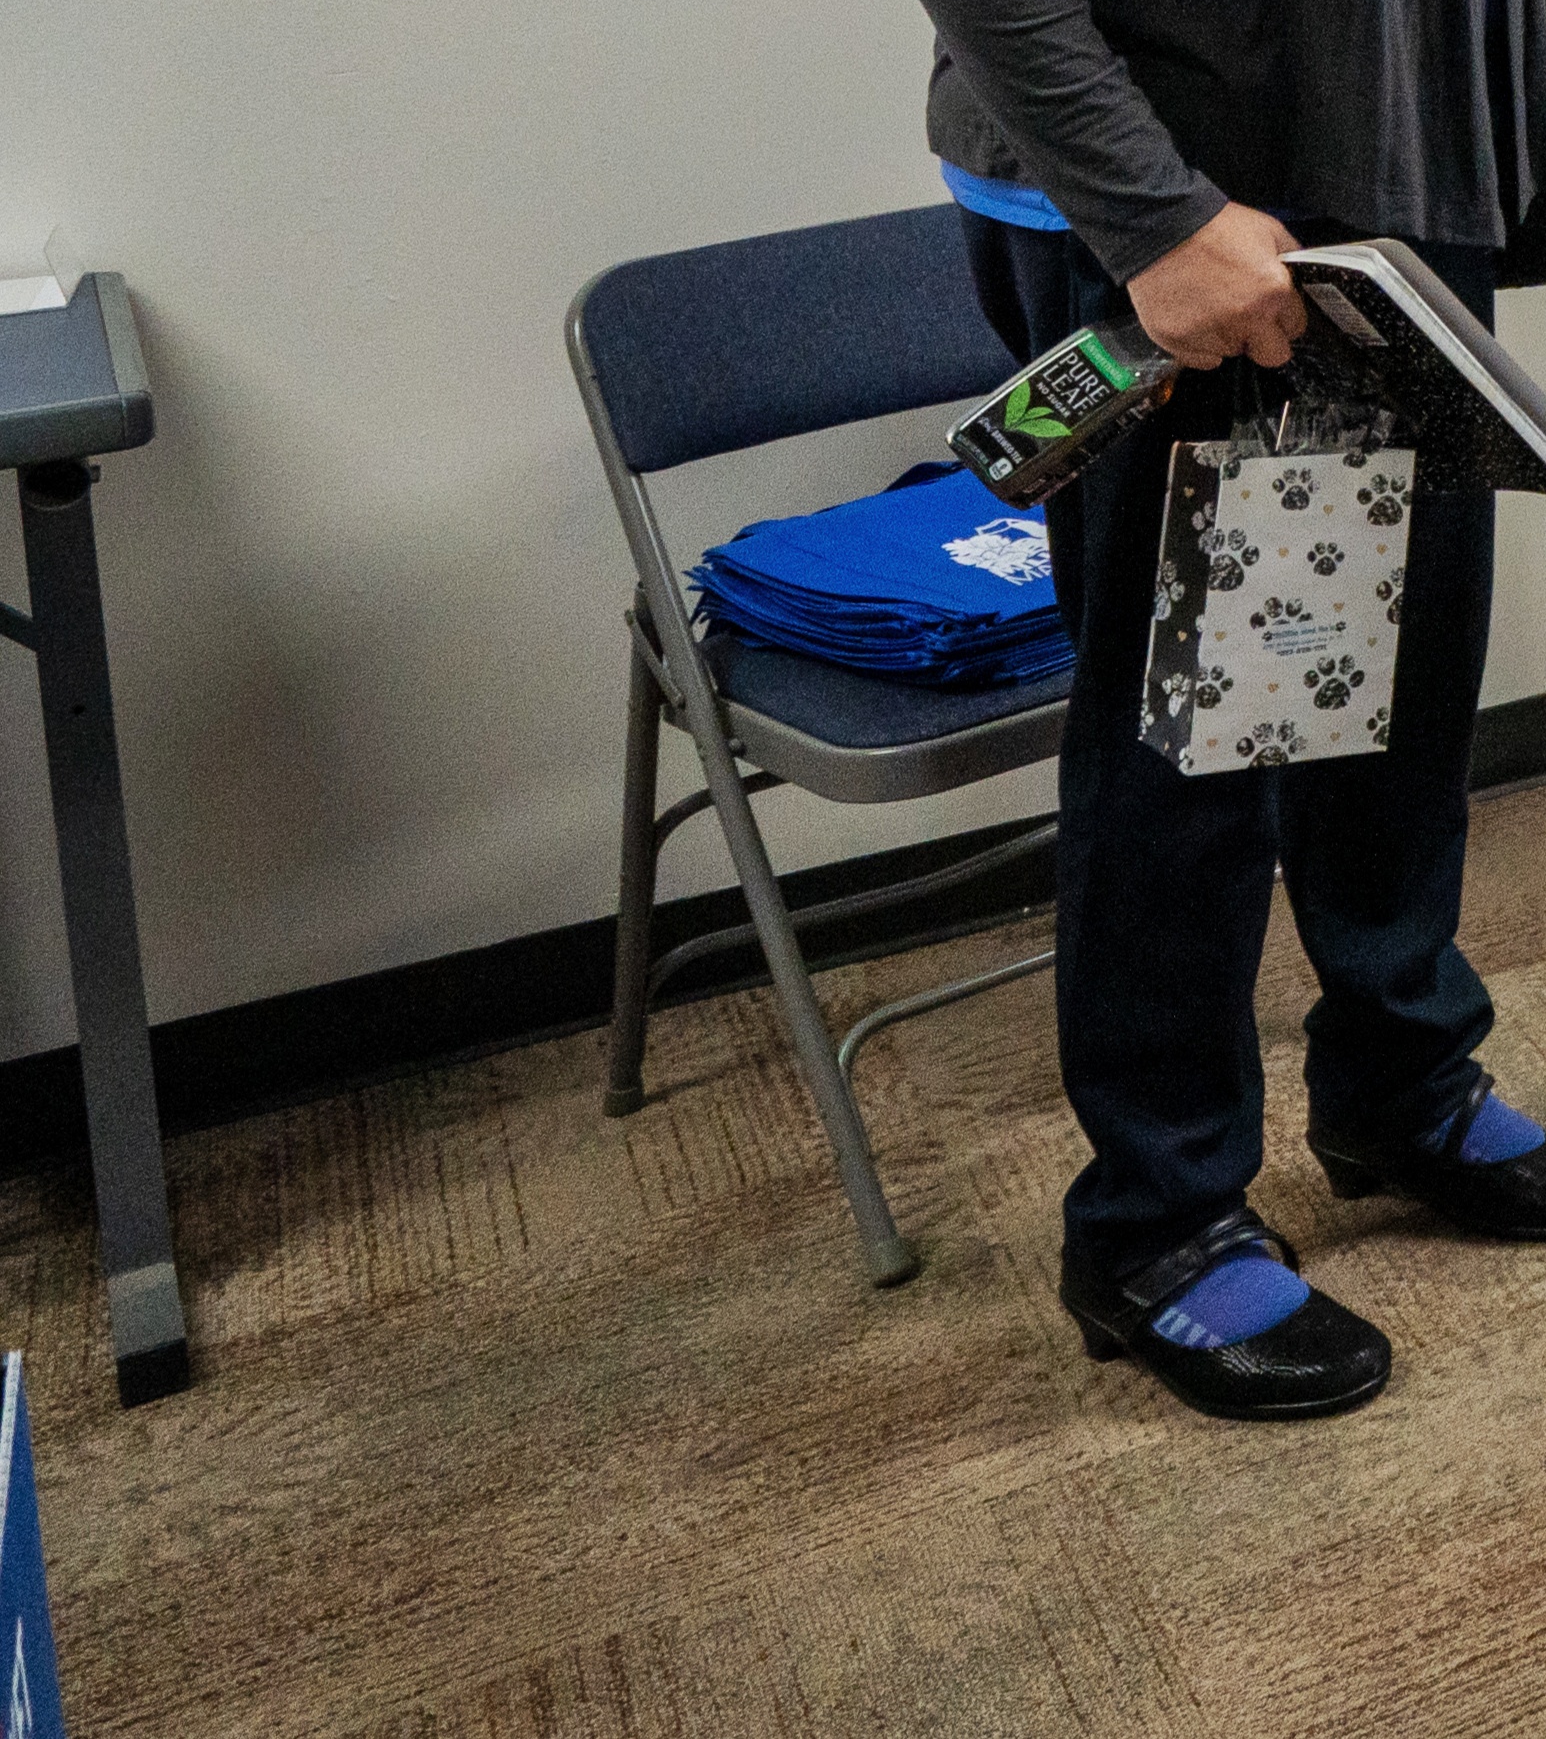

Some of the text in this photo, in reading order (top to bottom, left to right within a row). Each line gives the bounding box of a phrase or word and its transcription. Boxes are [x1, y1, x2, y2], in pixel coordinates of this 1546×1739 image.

[1042, 364, 1094, 413] LEAF
[1059, 351, 1111, 404] PURE
[1036, 382, 1072, 418] NO SUGAR
[991, 430, 1014, 455] BREWED
